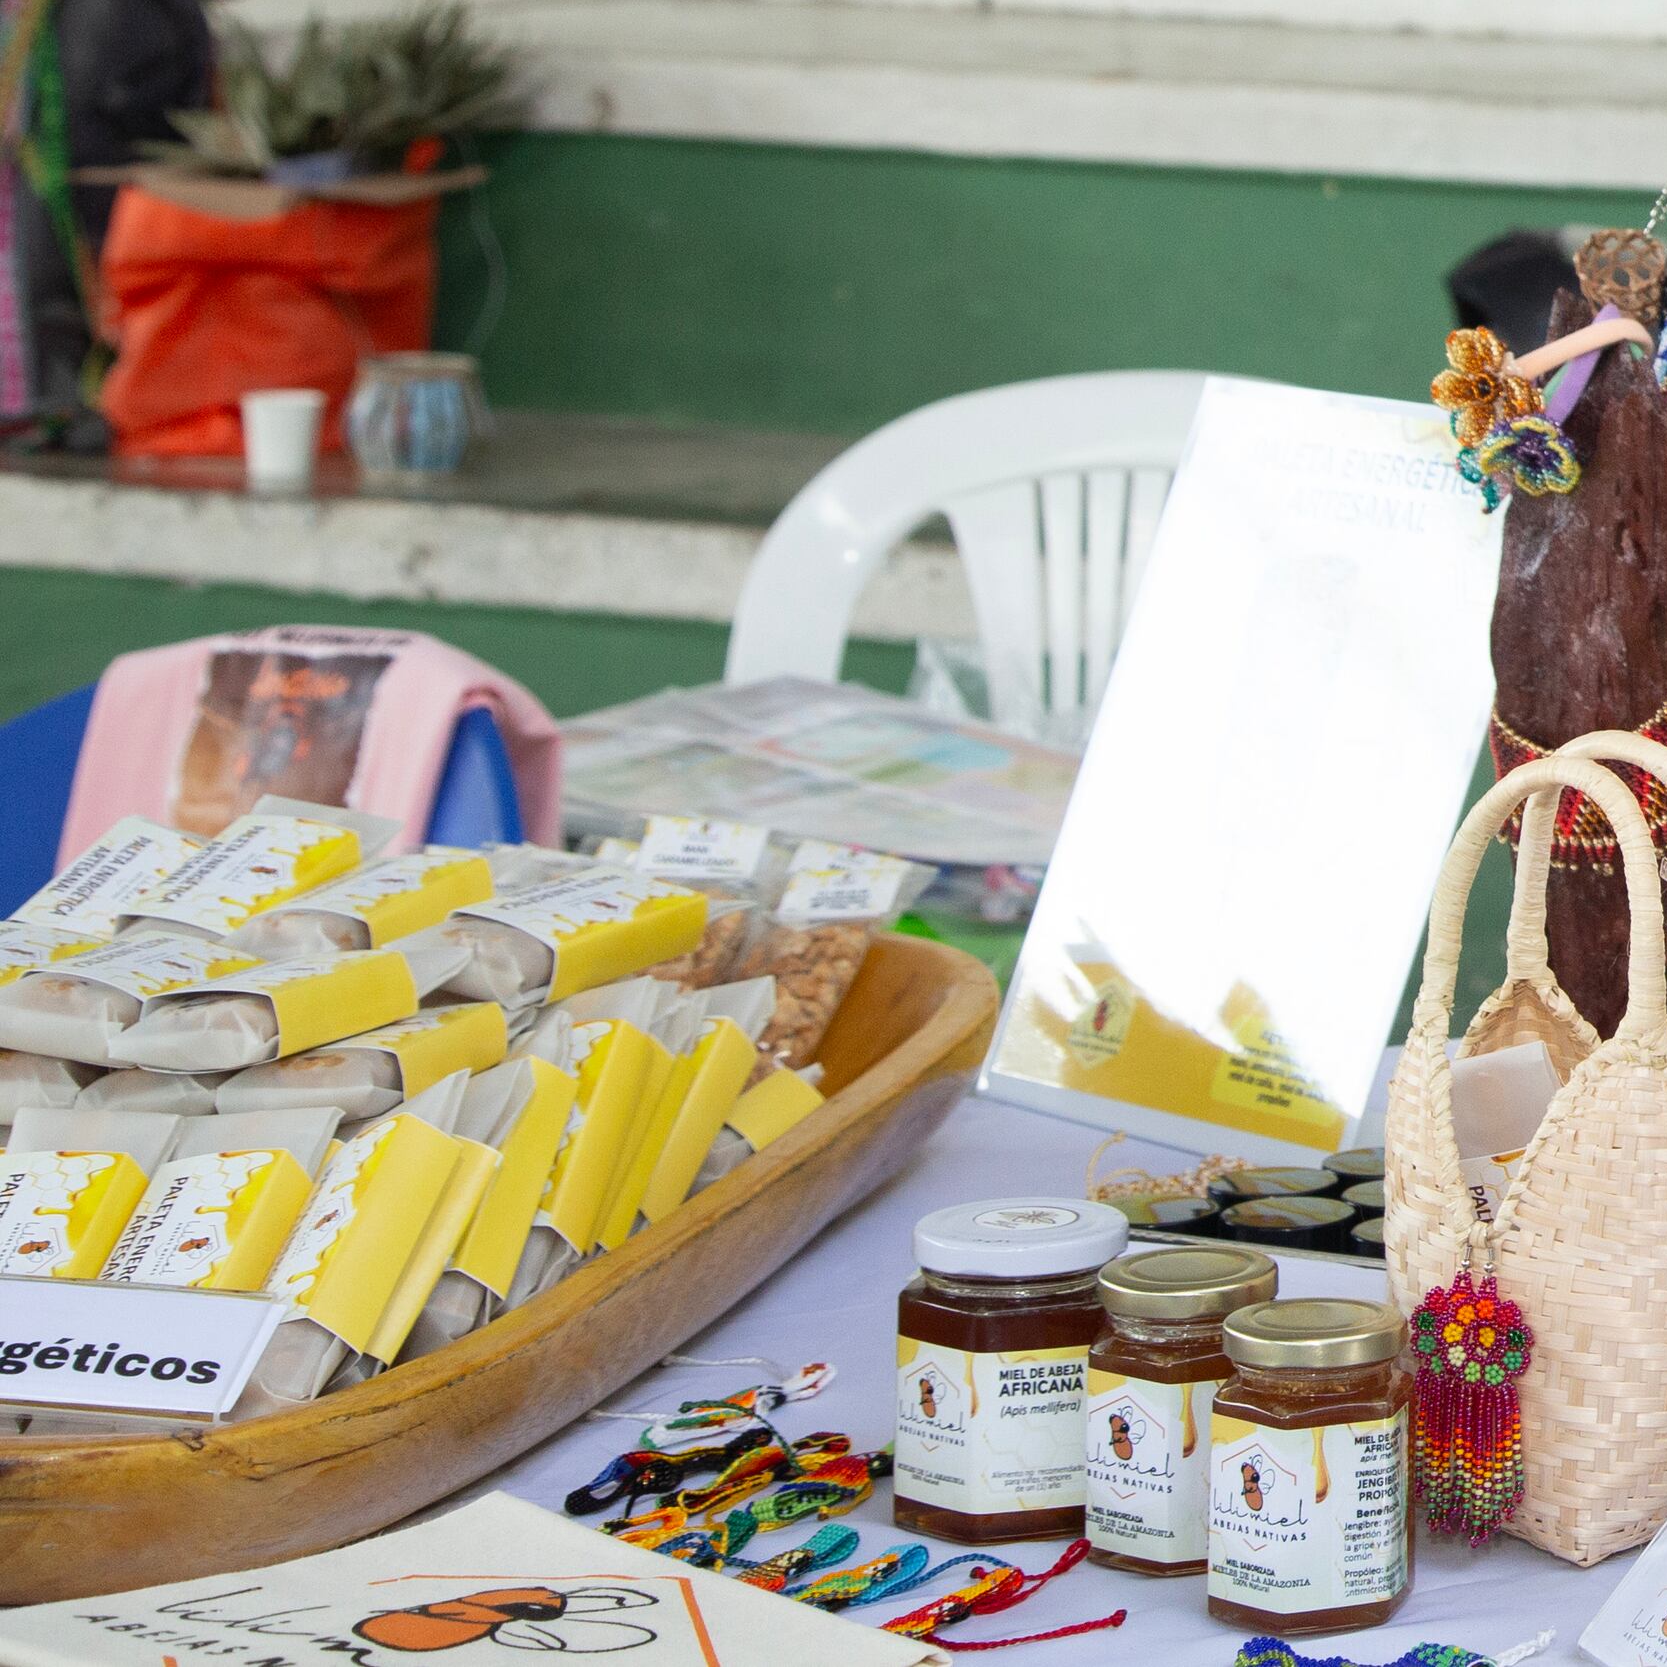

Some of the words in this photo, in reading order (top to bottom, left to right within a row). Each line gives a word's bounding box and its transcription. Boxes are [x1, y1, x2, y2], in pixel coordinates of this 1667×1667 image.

[113, 836, 154, 866] PALETA
[48, 846, 111, 893] ARTESANAL
[145, 1177, 189, 1232] PALETA
[1000, 1368, 1026, 1380] MIEL
[1030, 1367, 1044, 1378] DE
[1047, 1364, 1084, 1377] ABEJA
[1000, 1377, 1084, 1397] AFRICANA
[1000, 1405, 1028, 1418] (Apis
[1030, 1399, 1081, 1415] mellifera)
[929, 1432, 965, 1447] NATIVAS
[1355, 1435, 1375, 1445] MIEL
[1123, 1478, 1173, 1493] NATIVAS
[1213, 1518, 1249, 1534] ABEJAS
[1255, 1529, 1306, 1542] NATIVAS
[1344, 1521, 1381, 1530] Jengibre:
[1345, 1568, 1384, 1578] Propóleo:
[1263, 1576, 1311, 1588] AMAZONIA
